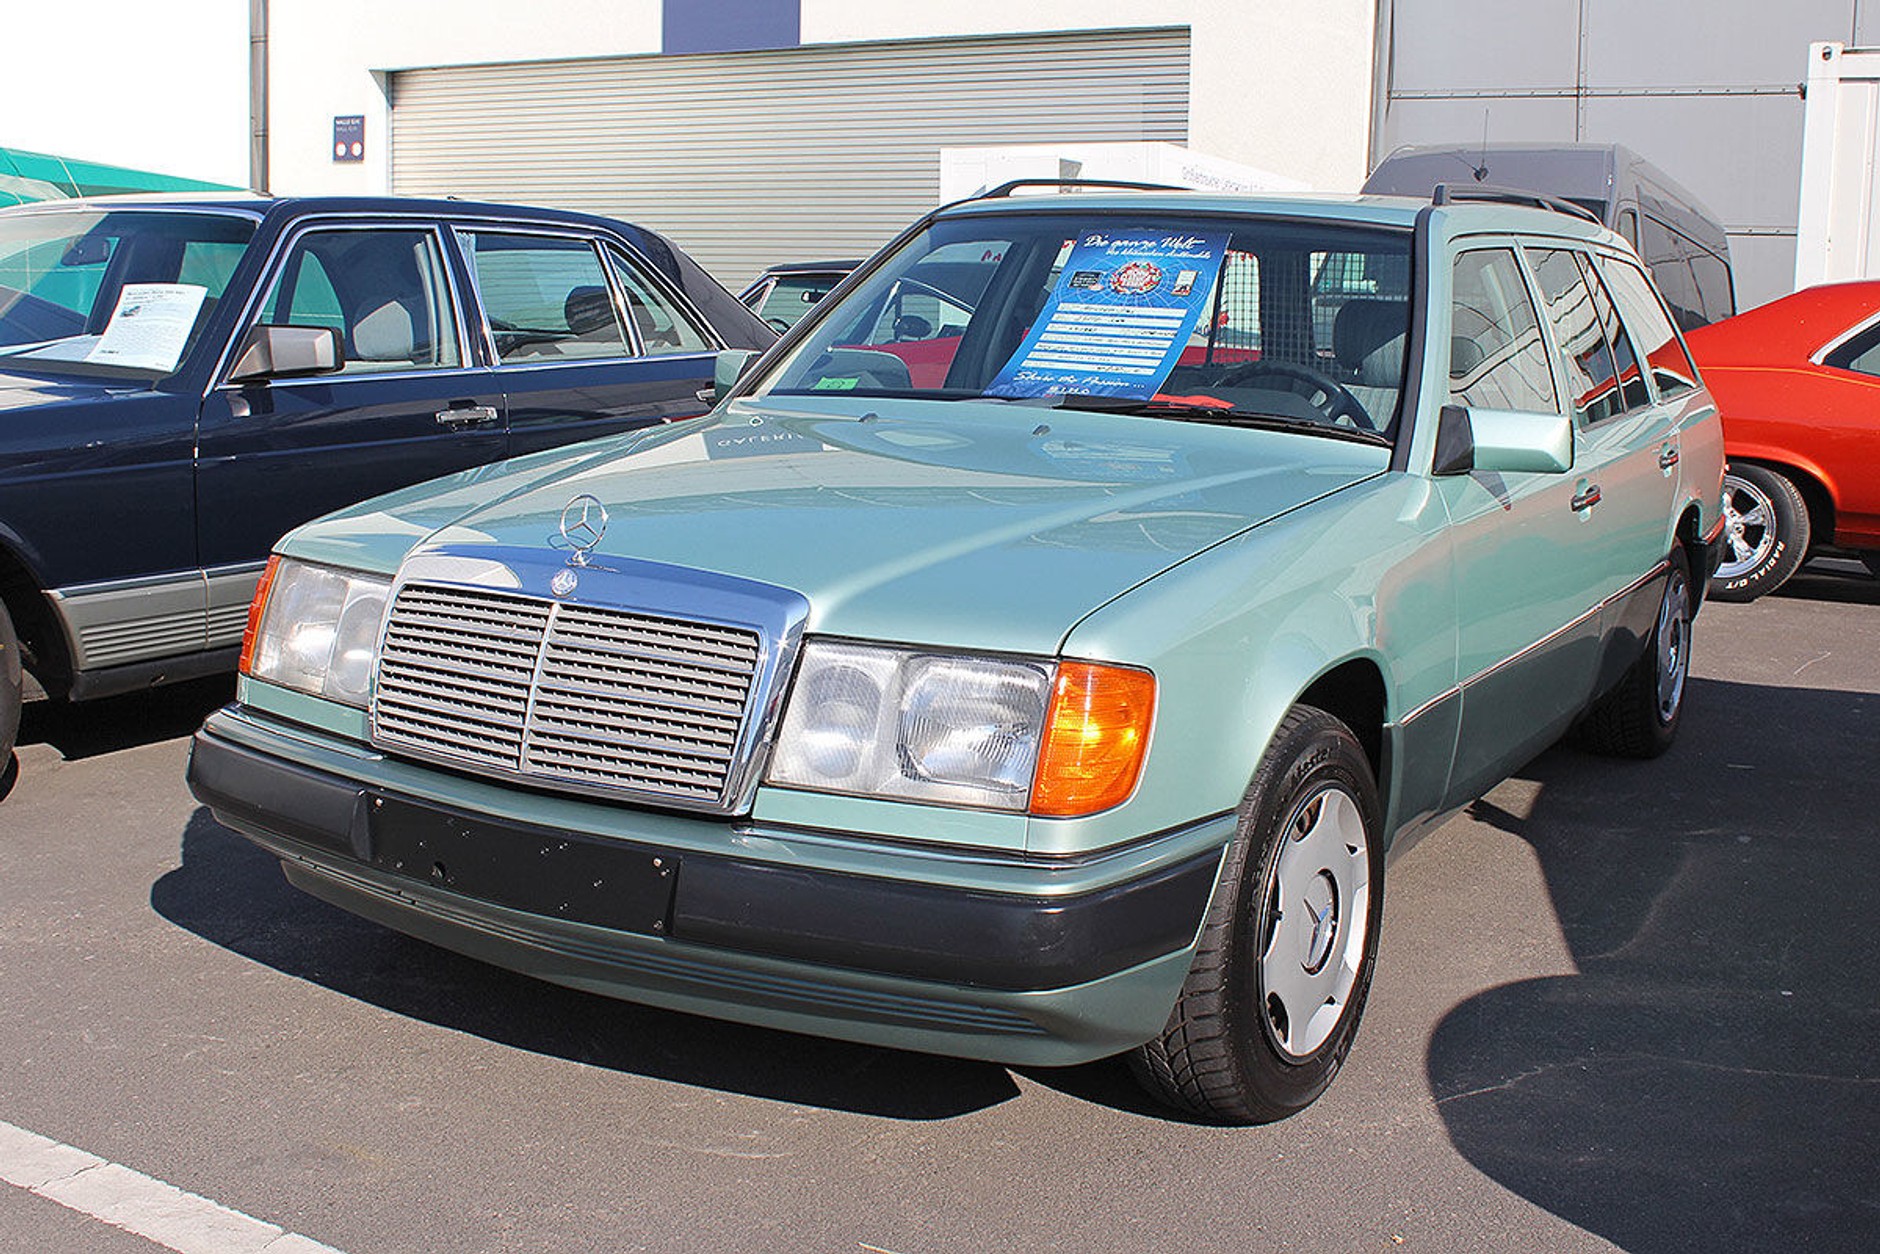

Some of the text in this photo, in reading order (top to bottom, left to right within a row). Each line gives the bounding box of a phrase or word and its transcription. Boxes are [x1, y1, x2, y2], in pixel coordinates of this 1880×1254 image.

[1083, 233, 1206, 253] Die ganze Welt
[1750, 541, 1786, 580] RADIAL
